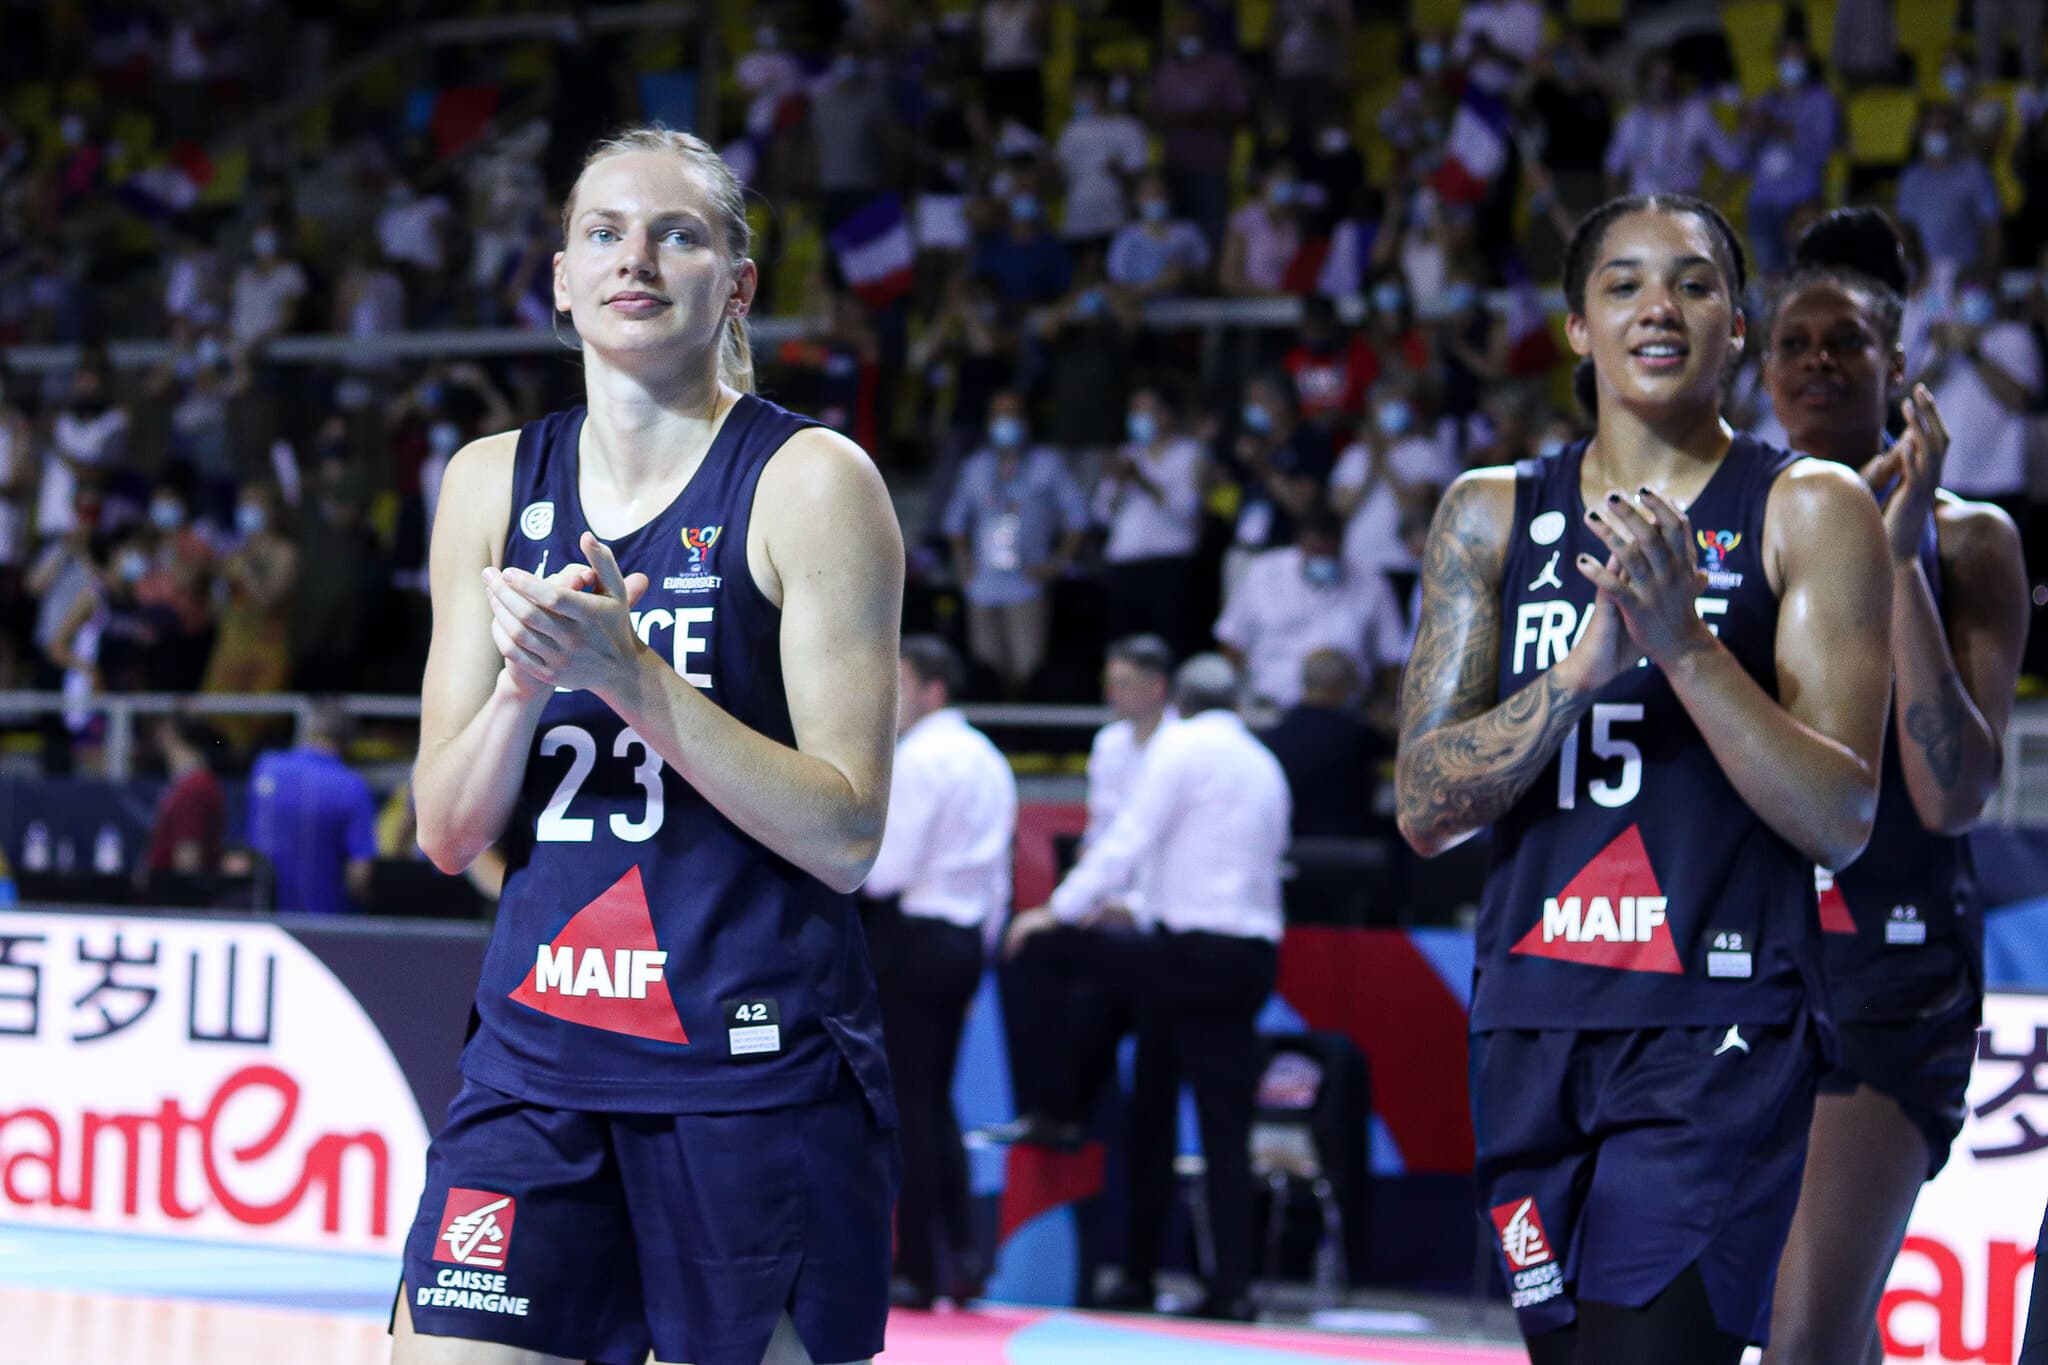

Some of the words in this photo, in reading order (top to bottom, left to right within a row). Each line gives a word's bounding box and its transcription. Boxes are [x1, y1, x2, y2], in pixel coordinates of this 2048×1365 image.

[1557, 703, 1644, 810] 15
[536, 725, 665, 842] 23
[1542, 896, 1667, 943] MAIF
[1713, 932, 1743, 951] 42
[535, 944, 668, 999] MAIF
[735, 1003, 768, 1022] 42
[436, 1269, 507, 1293] CAISSE
[416, 1287, 530, 1316] D'EPARGNE
